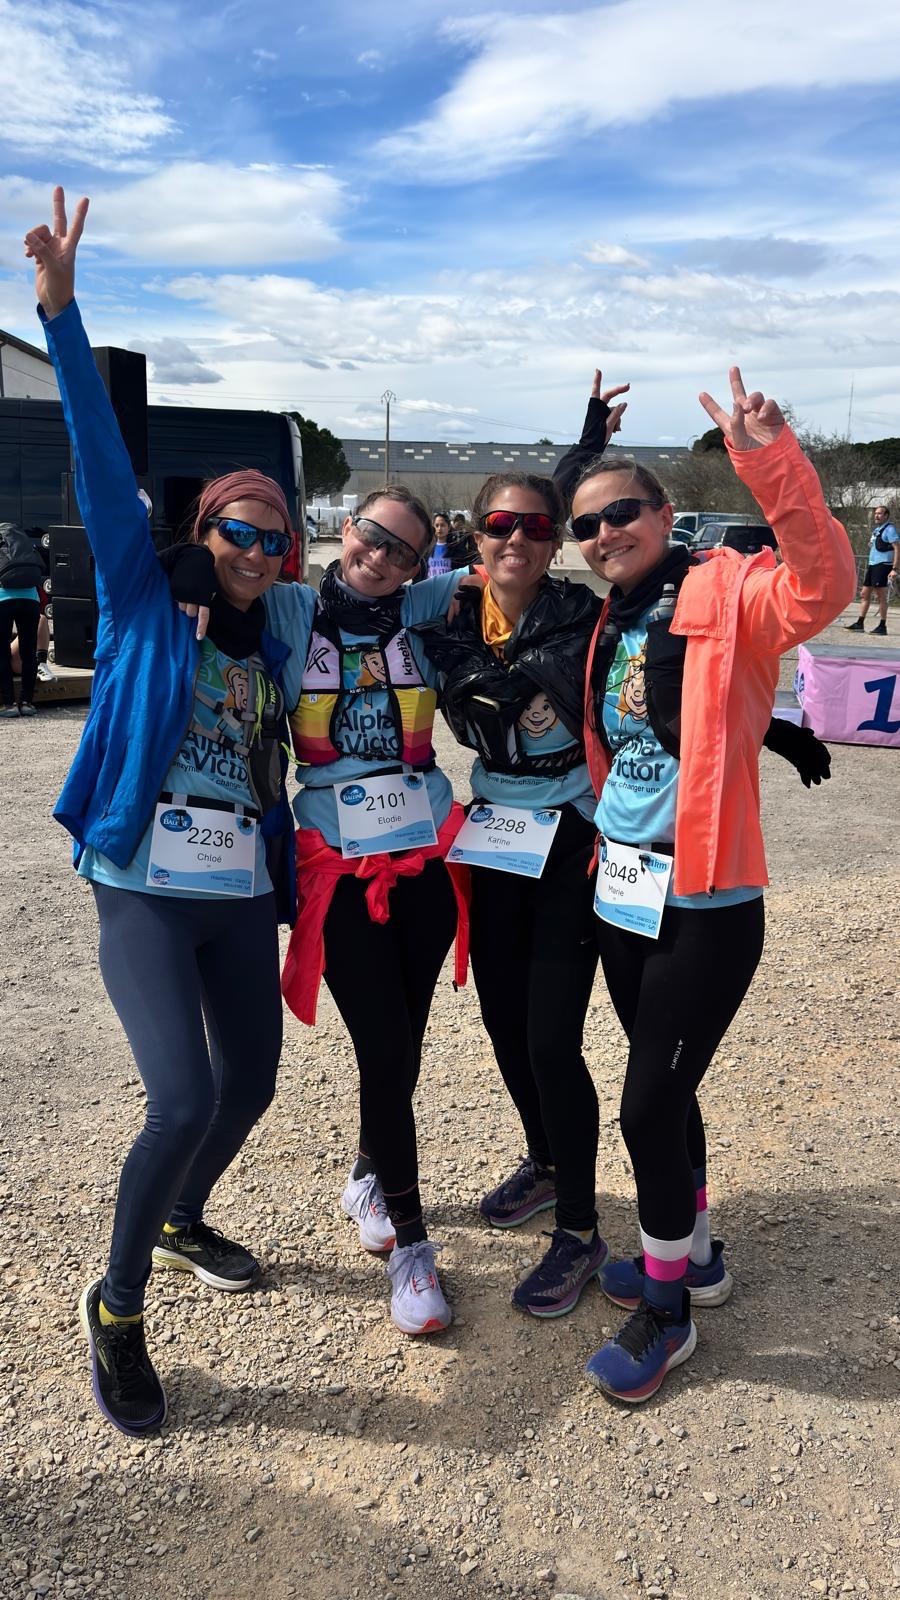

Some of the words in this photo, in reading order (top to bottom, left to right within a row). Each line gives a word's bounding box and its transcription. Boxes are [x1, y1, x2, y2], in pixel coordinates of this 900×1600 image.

[856, 674, 900, 734] 1
[344, 733, 400, 754] Victo
[612, 756, 665, 782] ictor
[645, 786, 661, 794] une
[365, 791, 406, 812] 2101
[377, 815, 402, 825] Elodie
[484, 817, 526, 834] 2298
[187, 827, 234, 849] 2236
[487, 835, 511, 847] Karine
[197, 852, 222, 863] Chloé
[604, 859, 638, 884] 2048
[608, 884, 625, 897] Marie
